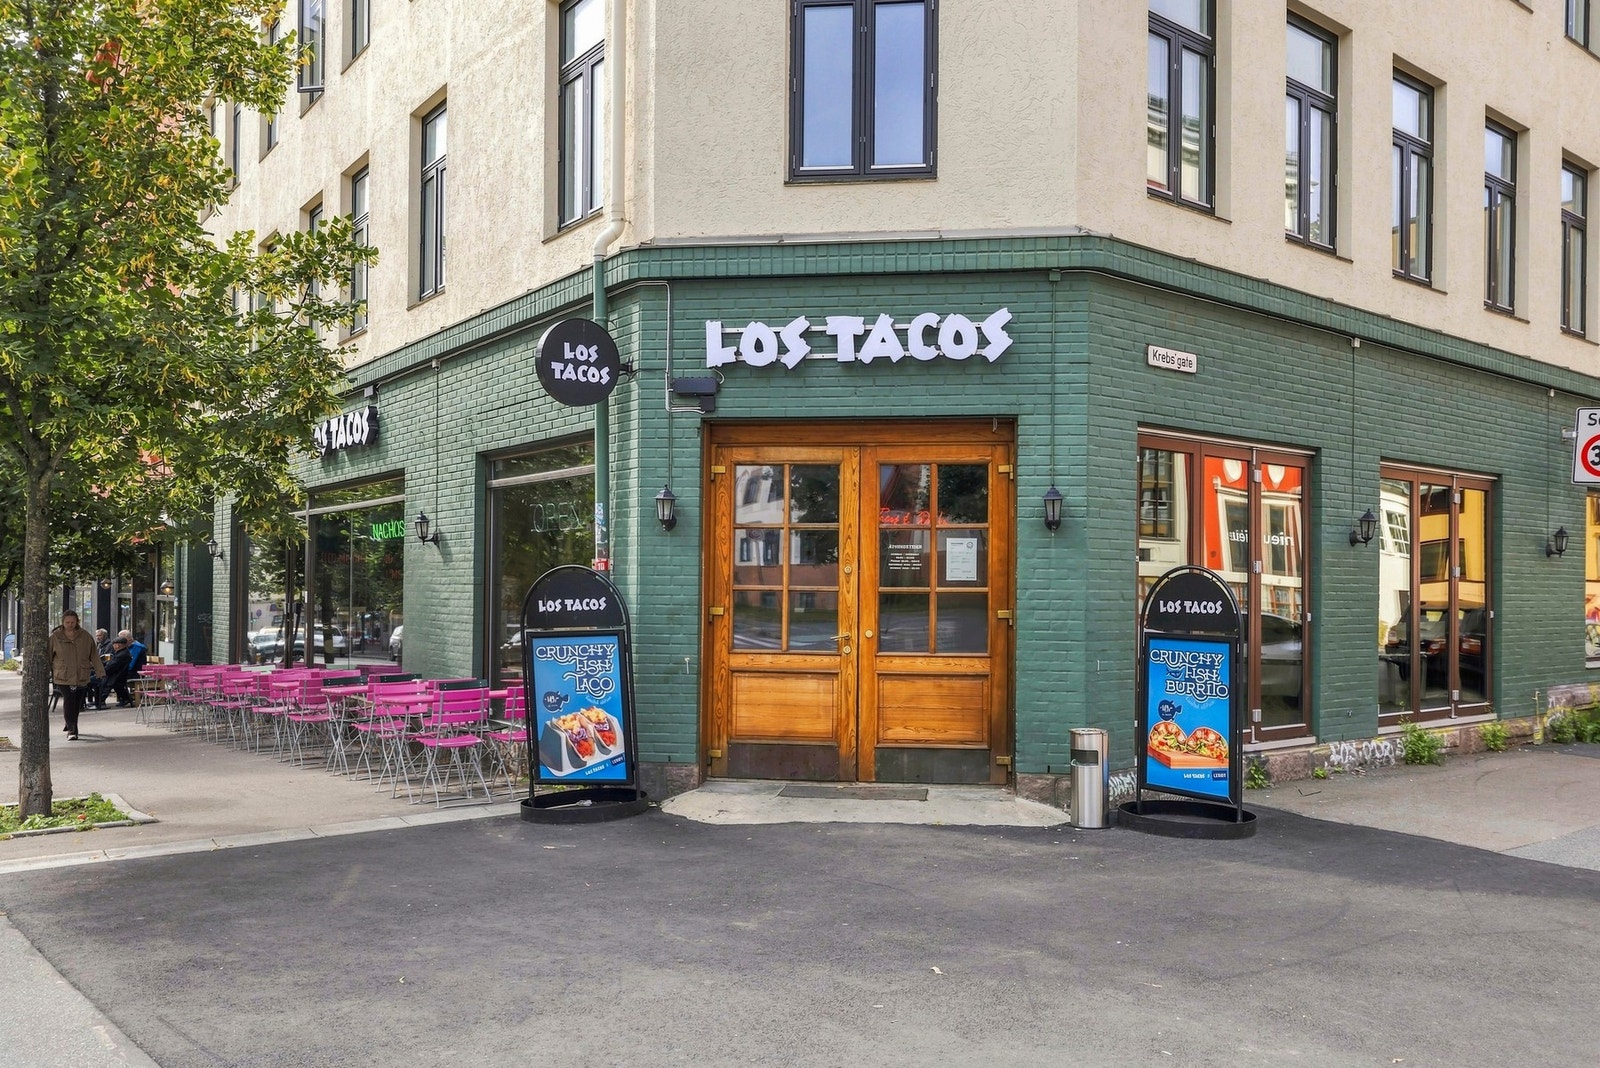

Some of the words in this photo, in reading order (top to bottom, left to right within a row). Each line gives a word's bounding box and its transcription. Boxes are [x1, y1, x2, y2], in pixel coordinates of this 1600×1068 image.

[706, 315, 811, 369] LOS
[825, 307, 1013, 364] TACOS
[563, 342, 598, 363] LOS
[1177, 356, 1193, 369] gate
[551, 361, 610, 385] TACOS
[1587, 412, 1600, 426] S
[314, 420, 329, 456] OS
[330, 405, 370, 449] TACOS
[372, 520, 405, 539] NACHOS
[538, 598, 562, 612] LOS
[564, 597, 607, 611] TACOS
[1159, 599, 1181, 614] LOS
[1183, 600, 1223, 614] TACOS
[536, 643, 616, 665] CRUNCHY
[1150, 649, 1225, 670] CRUNCHY
[569, 656, 614, 675] FISH
[1179, 663, 1221, 682] FISH
[563, 672, 615, 699] TACO
[1165, 679, 1229, 703] BURRITO
